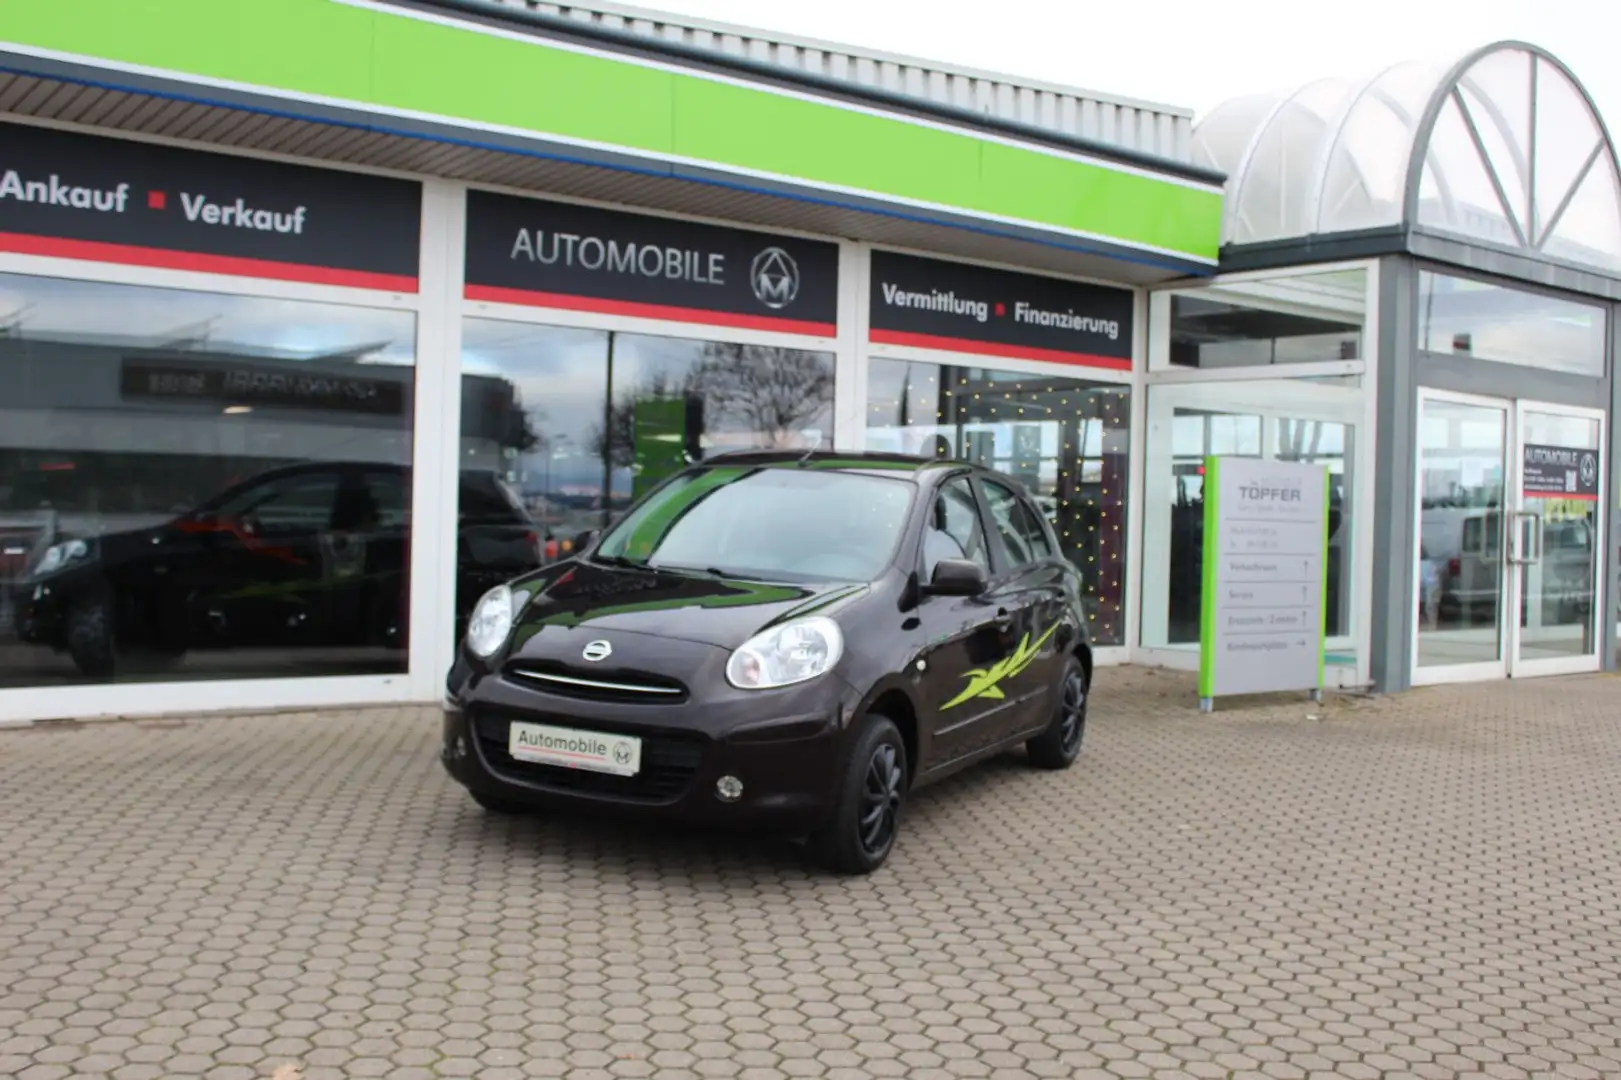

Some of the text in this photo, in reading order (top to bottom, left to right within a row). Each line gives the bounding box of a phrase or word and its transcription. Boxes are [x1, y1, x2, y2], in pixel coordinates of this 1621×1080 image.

[0, 171, 307, 234] Ankauf Verkauf
[511, 228, 725, 285] AUTOMOBILE
[881, 282, 1119, 340] Vermittlung Finanzierung
[518, 730, 607, 755] Automobile
